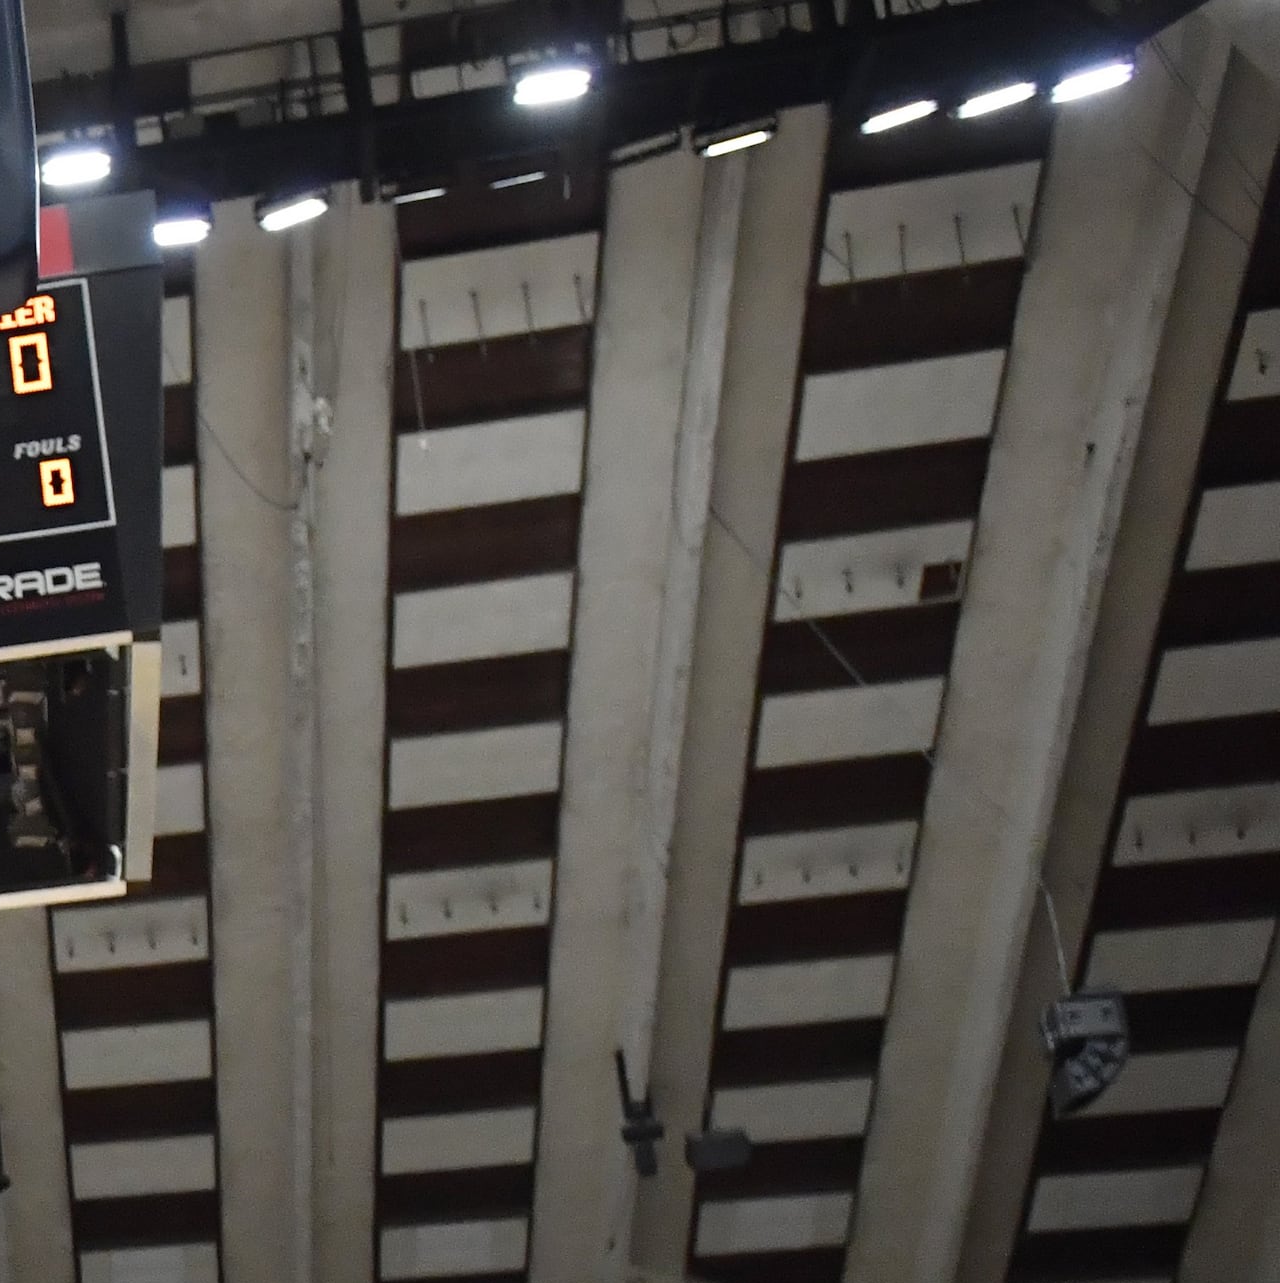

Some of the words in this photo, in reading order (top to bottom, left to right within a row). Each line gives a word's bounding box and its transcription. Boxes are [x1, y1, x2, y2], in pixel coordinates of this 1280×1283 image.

[8, 331, 53, 394] 0
[13, 434, 81, 460] FOULS
[39, 457, 75, 507] 0
